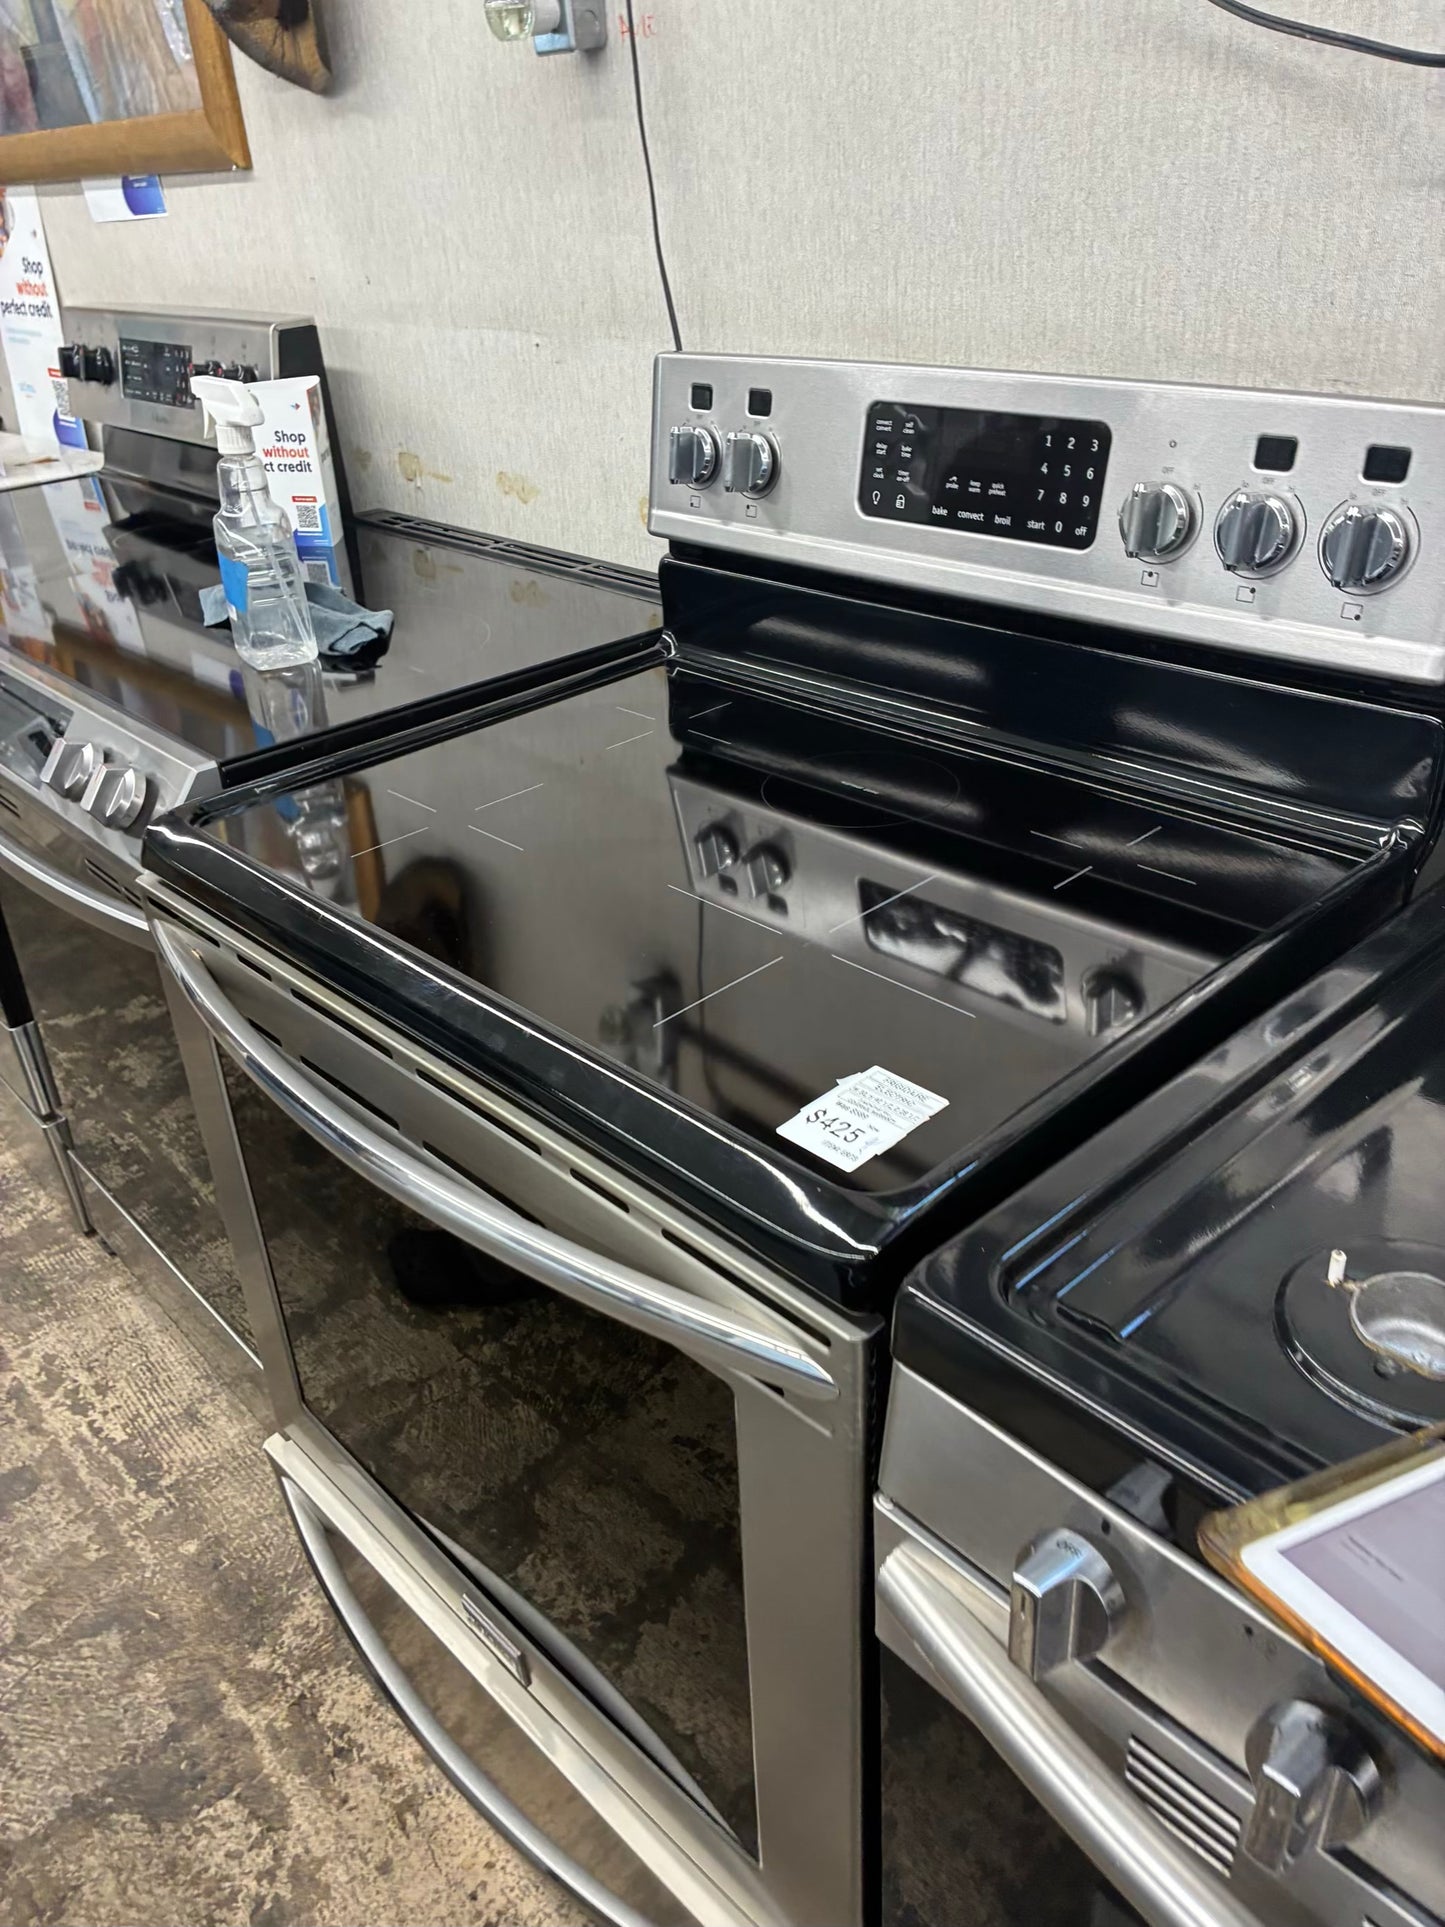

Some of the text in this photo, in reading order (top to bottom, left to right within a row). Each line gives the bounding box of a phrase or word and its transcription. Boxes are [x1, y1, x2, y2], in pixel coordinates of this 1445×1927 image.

[22, 256, 43, 278] Shop
[16, 279, 48, 297] without
[1, 299, 53, 318] perfect credit
[274, 430, 306, 445] Shop
[1045, 435, 1099, 451] 1 2 3
[263, 445, 309, 458] without
[277, 460, 312, 473] credit
[1041, 462, 1094, 479] 4 5 6
[1038, 489, 1090, 507] 7 8 9
[932, 505, 1011, 526] bake convect broil
[1027, 520, 1087, 536] start 0 off
[806, 1108, 866, 1143] $425
